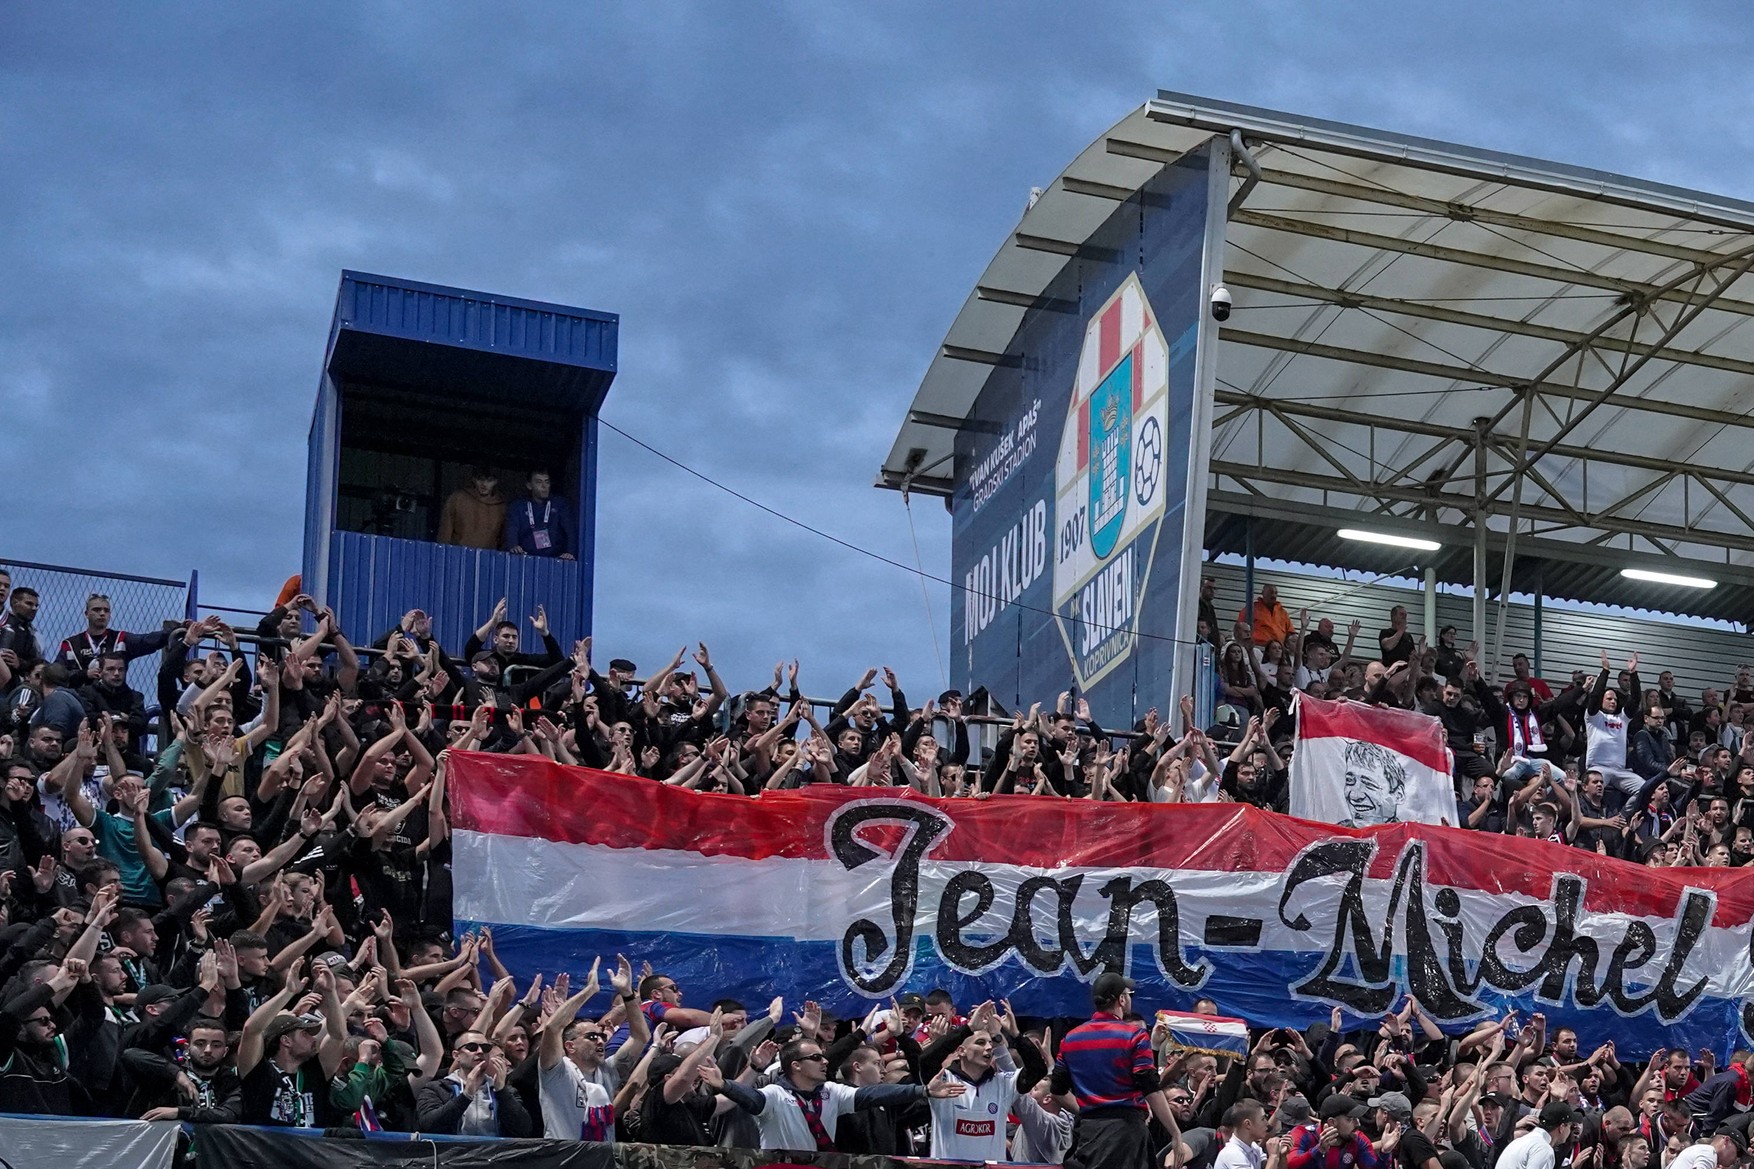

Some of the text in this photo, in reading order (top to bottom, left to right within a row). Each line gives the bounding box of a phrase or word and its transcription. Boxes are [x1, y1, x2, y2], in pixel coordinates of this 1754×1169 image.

[973, 429, 1037, 512] GRADSKI STADION
[964, 499, 1047, 646] MOJ KLUB
[1059, 505, 1086, 564] 1907
[1082, 547, 1132, 657] SLAVEN
[1083, 625, 1130, 679] KOPRIVNICA
